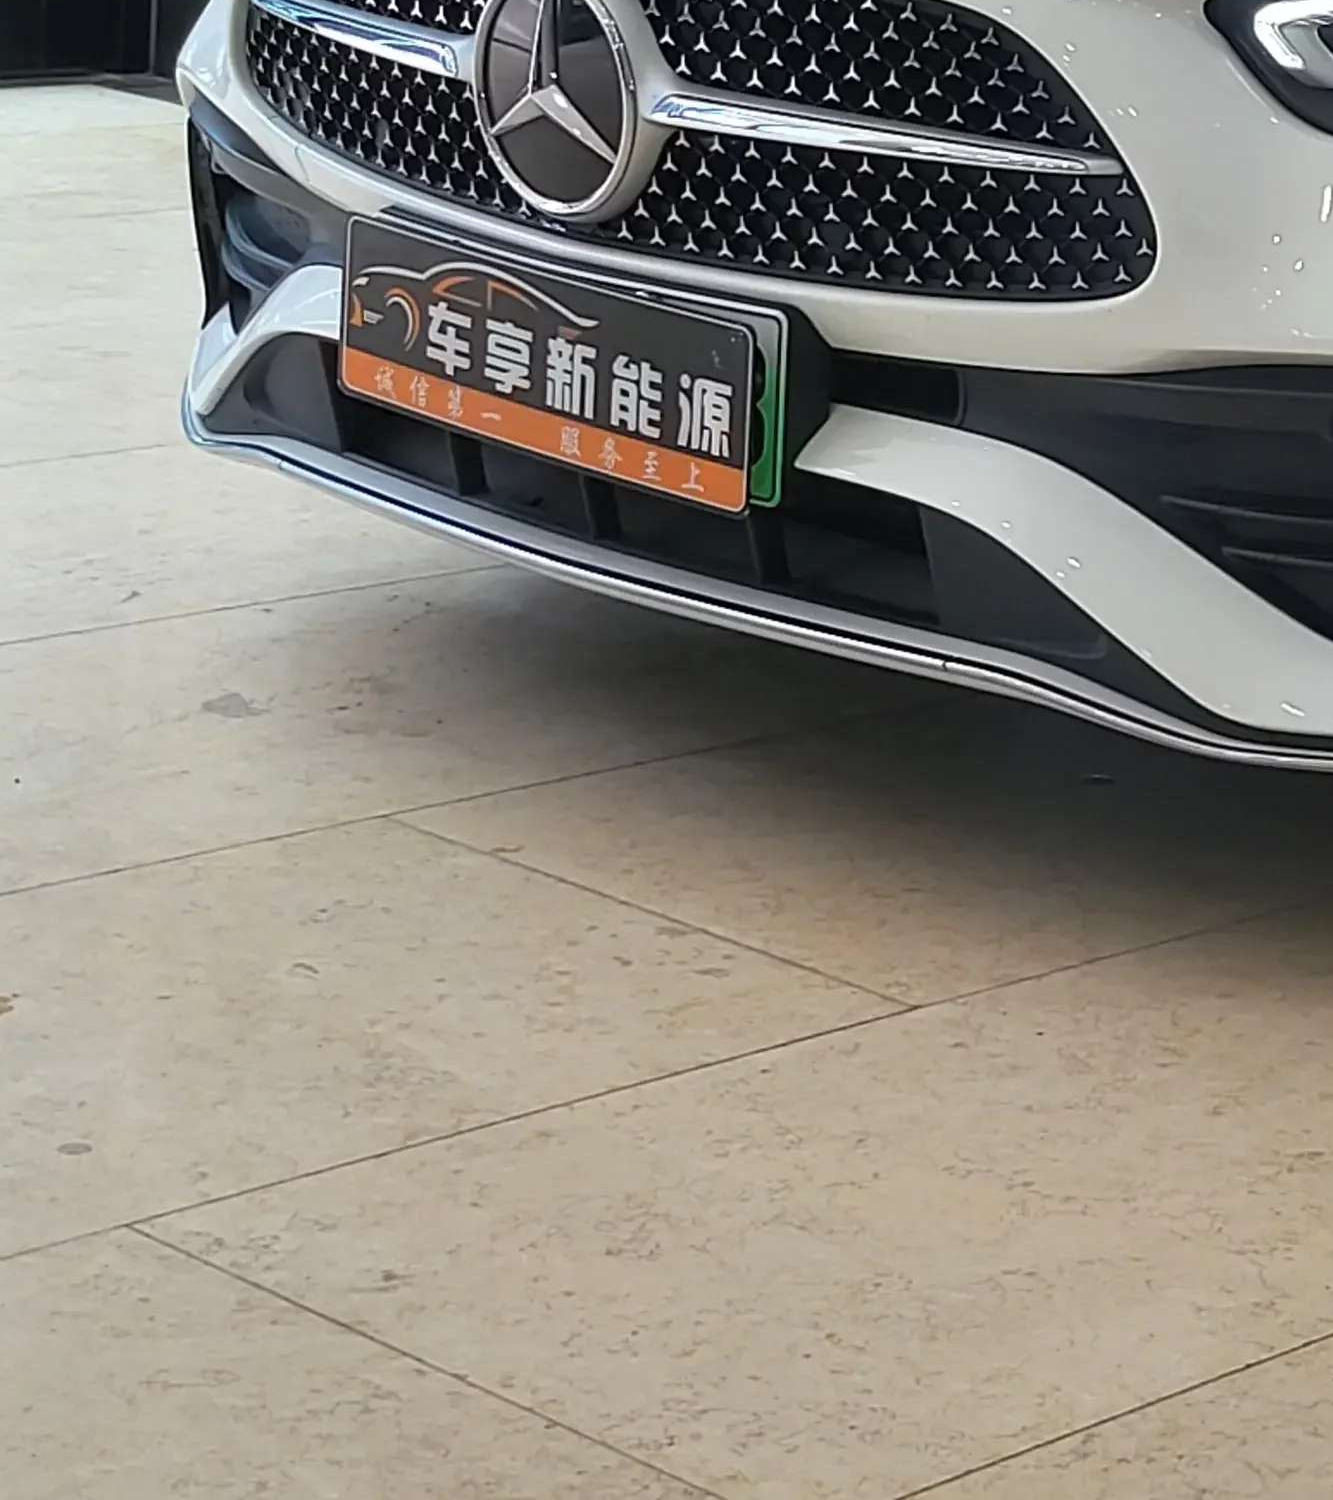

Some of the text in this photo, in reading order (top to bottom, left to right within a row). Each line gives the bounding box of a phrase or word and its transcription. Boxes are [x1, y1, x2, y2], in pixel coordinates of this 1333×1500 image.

[426, 302, 734, 458] 车享新能源
